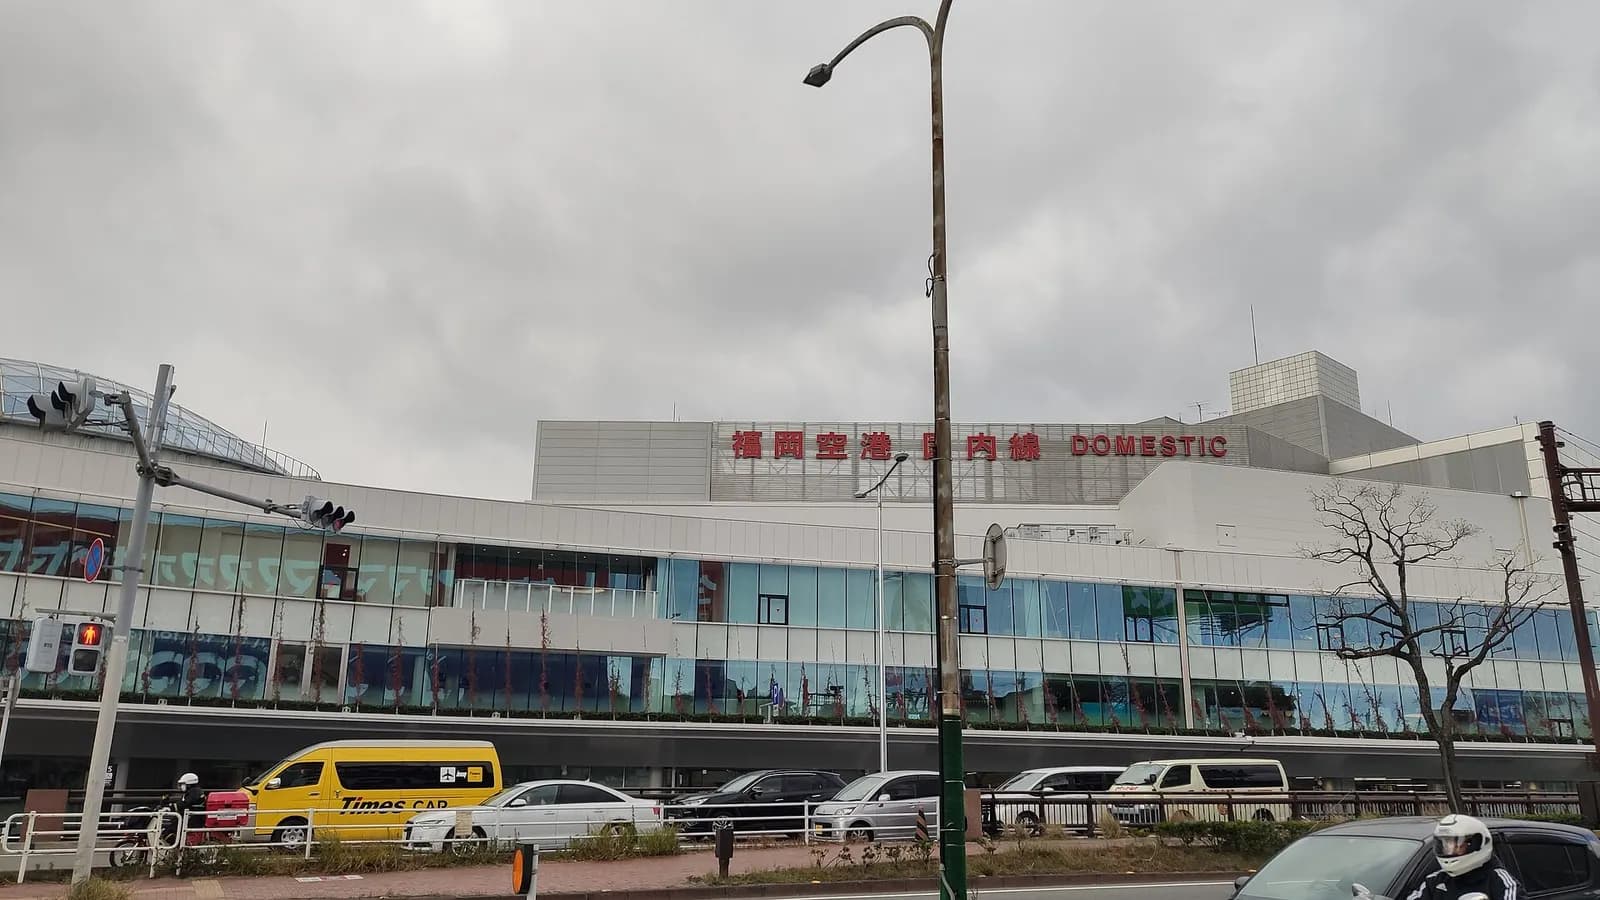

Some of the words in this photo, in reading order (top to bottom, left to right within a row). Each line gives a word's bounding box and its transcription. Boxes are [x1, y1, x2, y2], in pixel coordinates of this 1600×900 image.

[732, 430, 892, 461] 福岡空港
[1071, 435, 1228, 458] DOMESTIC
[340, 796, 407, 815] Times
